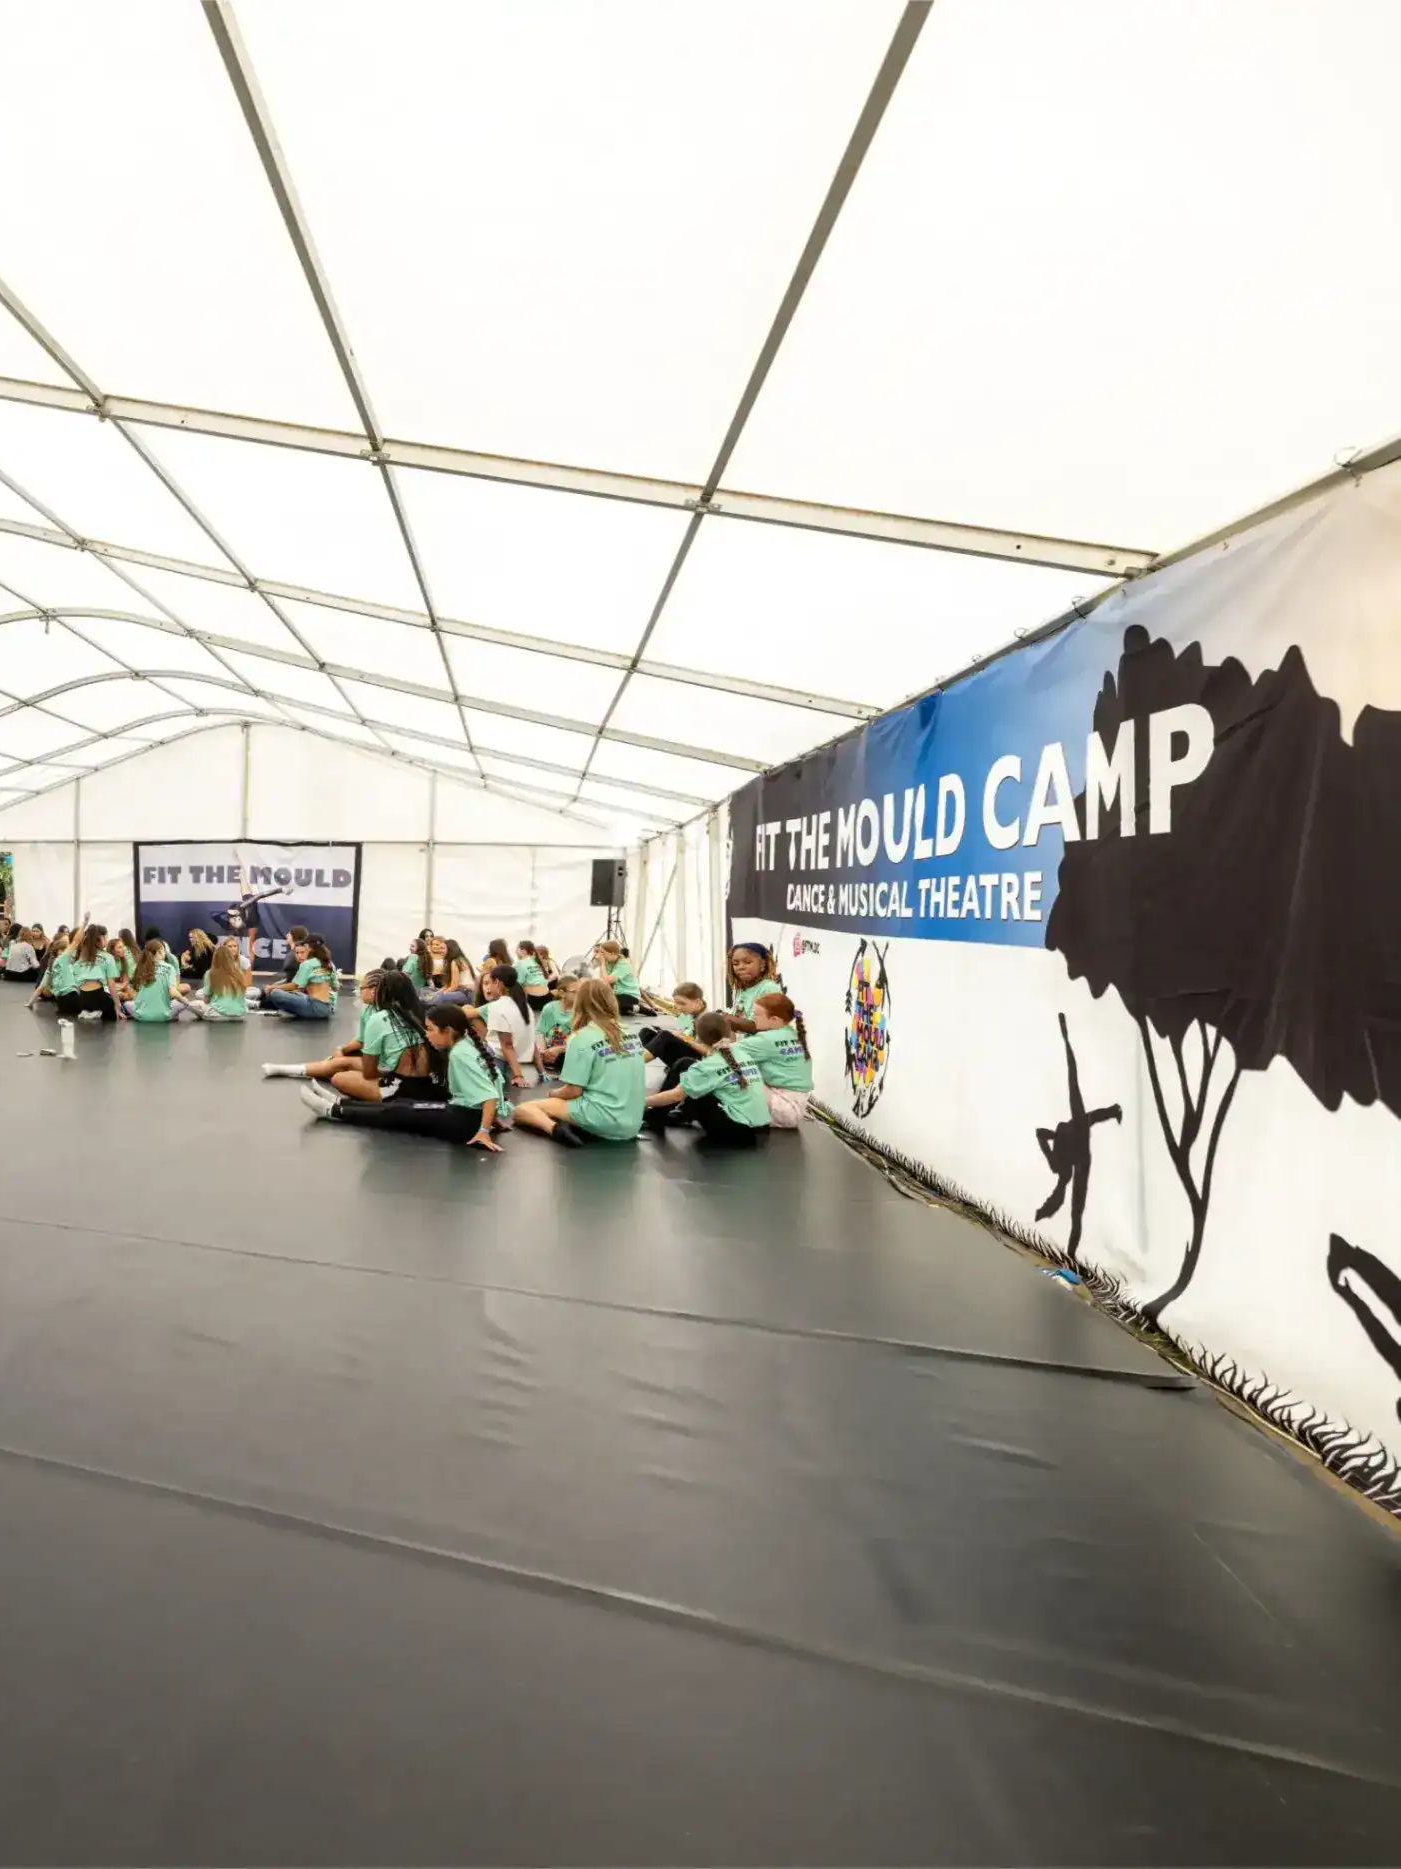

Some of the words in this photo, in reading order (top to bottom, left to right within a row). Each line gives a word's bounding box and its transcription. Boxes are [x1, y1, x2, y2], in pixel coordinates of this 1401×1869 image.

[756, 821, 781, 871] FIT
[786, 811, 831, 871] THE
[836, 773, 966, 868] MOULD
[983, 703, 1215, 850] CAMP
[143, 866, 182, 884] FIT
[189, 865, 242, 884] THE
[249, 866, 352, 888] MOULD
[786, 883, 825, 914] DANCE
[827, 885, 836, 914] &
[838, 881, 913, 917] MUSICAL
[918, 871, 1042, 921] THEATRE
